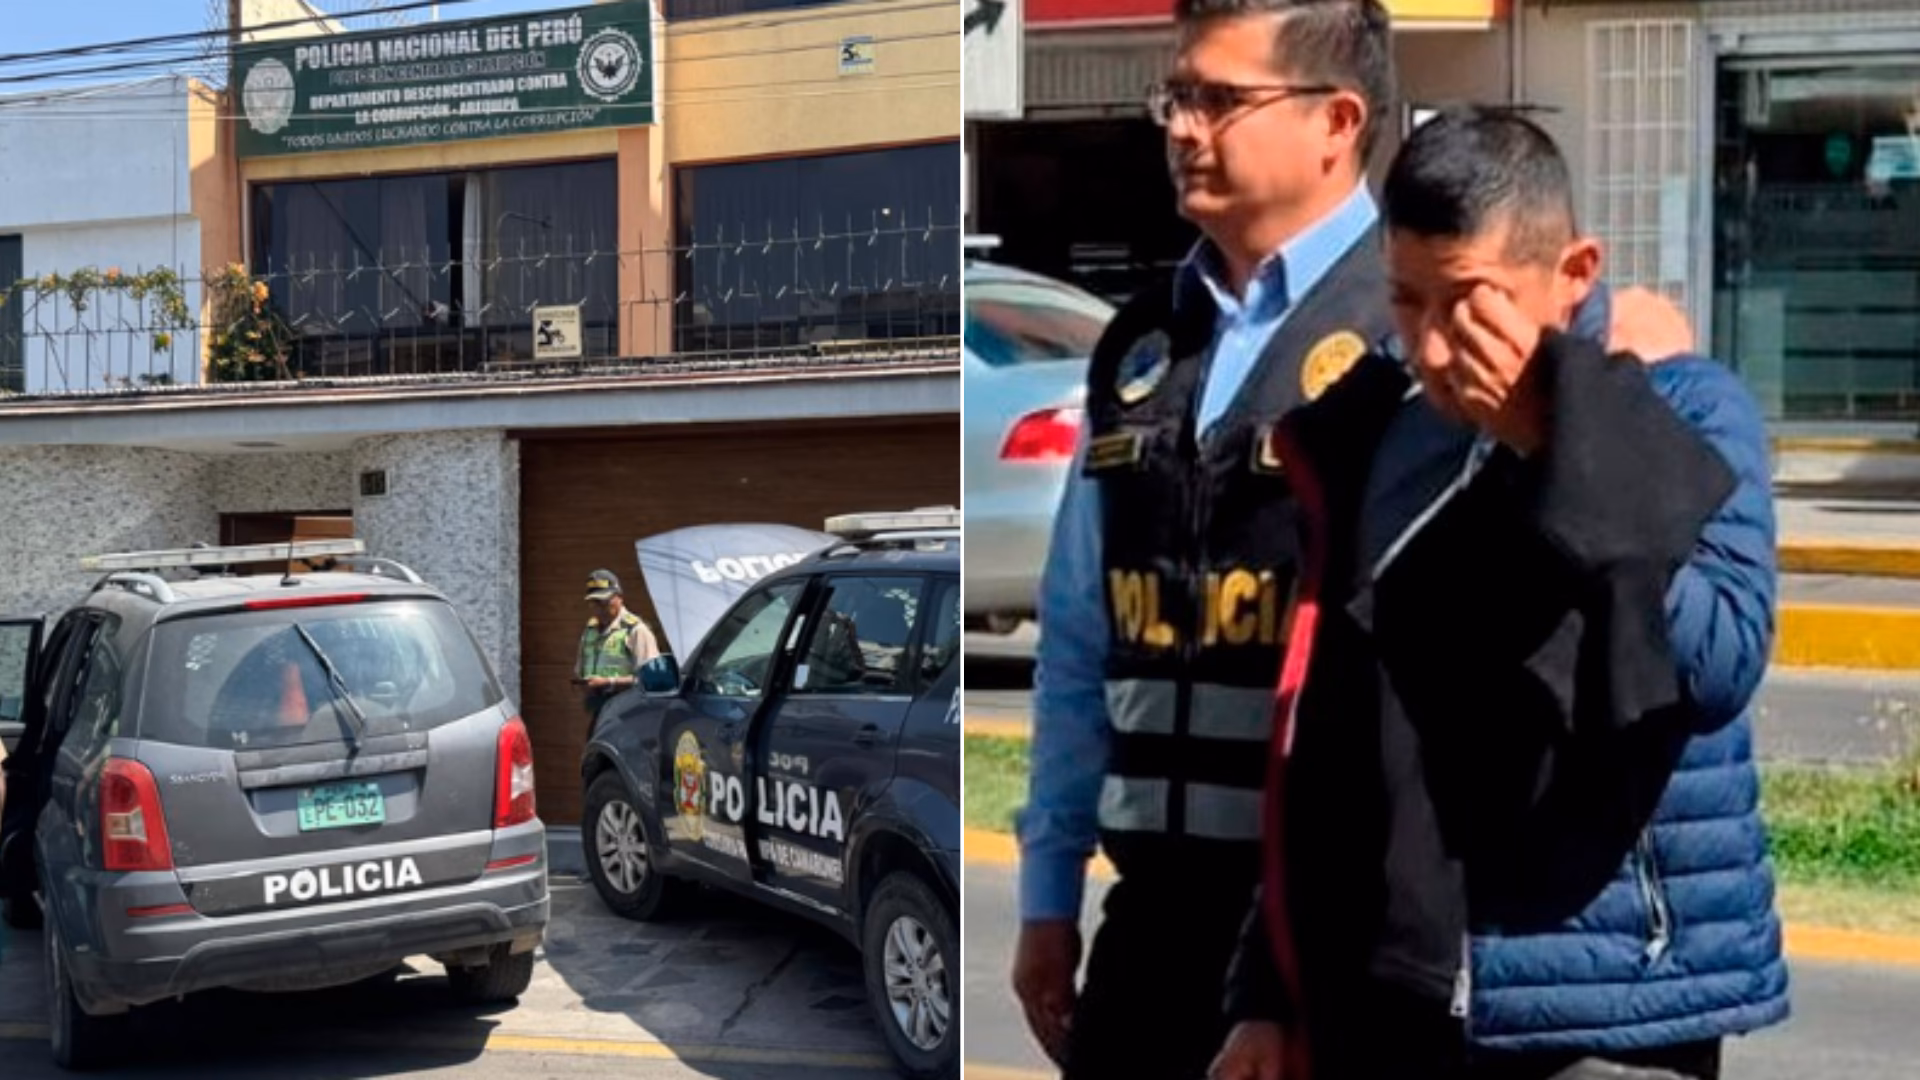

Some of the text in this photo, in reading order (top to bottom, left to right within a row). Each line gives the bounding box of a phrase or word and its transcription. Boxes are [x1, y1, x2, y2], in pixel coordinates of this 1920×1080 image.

[295, 12, 583, 71] POLICIA NACIONAL DEL PERÚ
[309, 72, 568, 110] DEPARTAMENTO DESCONCENTRADO CONTRA
[355, 110, 369, 125] LA
[460, 97, 519, 115] AREQUIPA
[443, 119, 493, 135] CONTRA
[494, 117, 511, 129] LA
[710, 770, 844, 843] POLICIA
[264, 857, 423, 904] POLICIA
